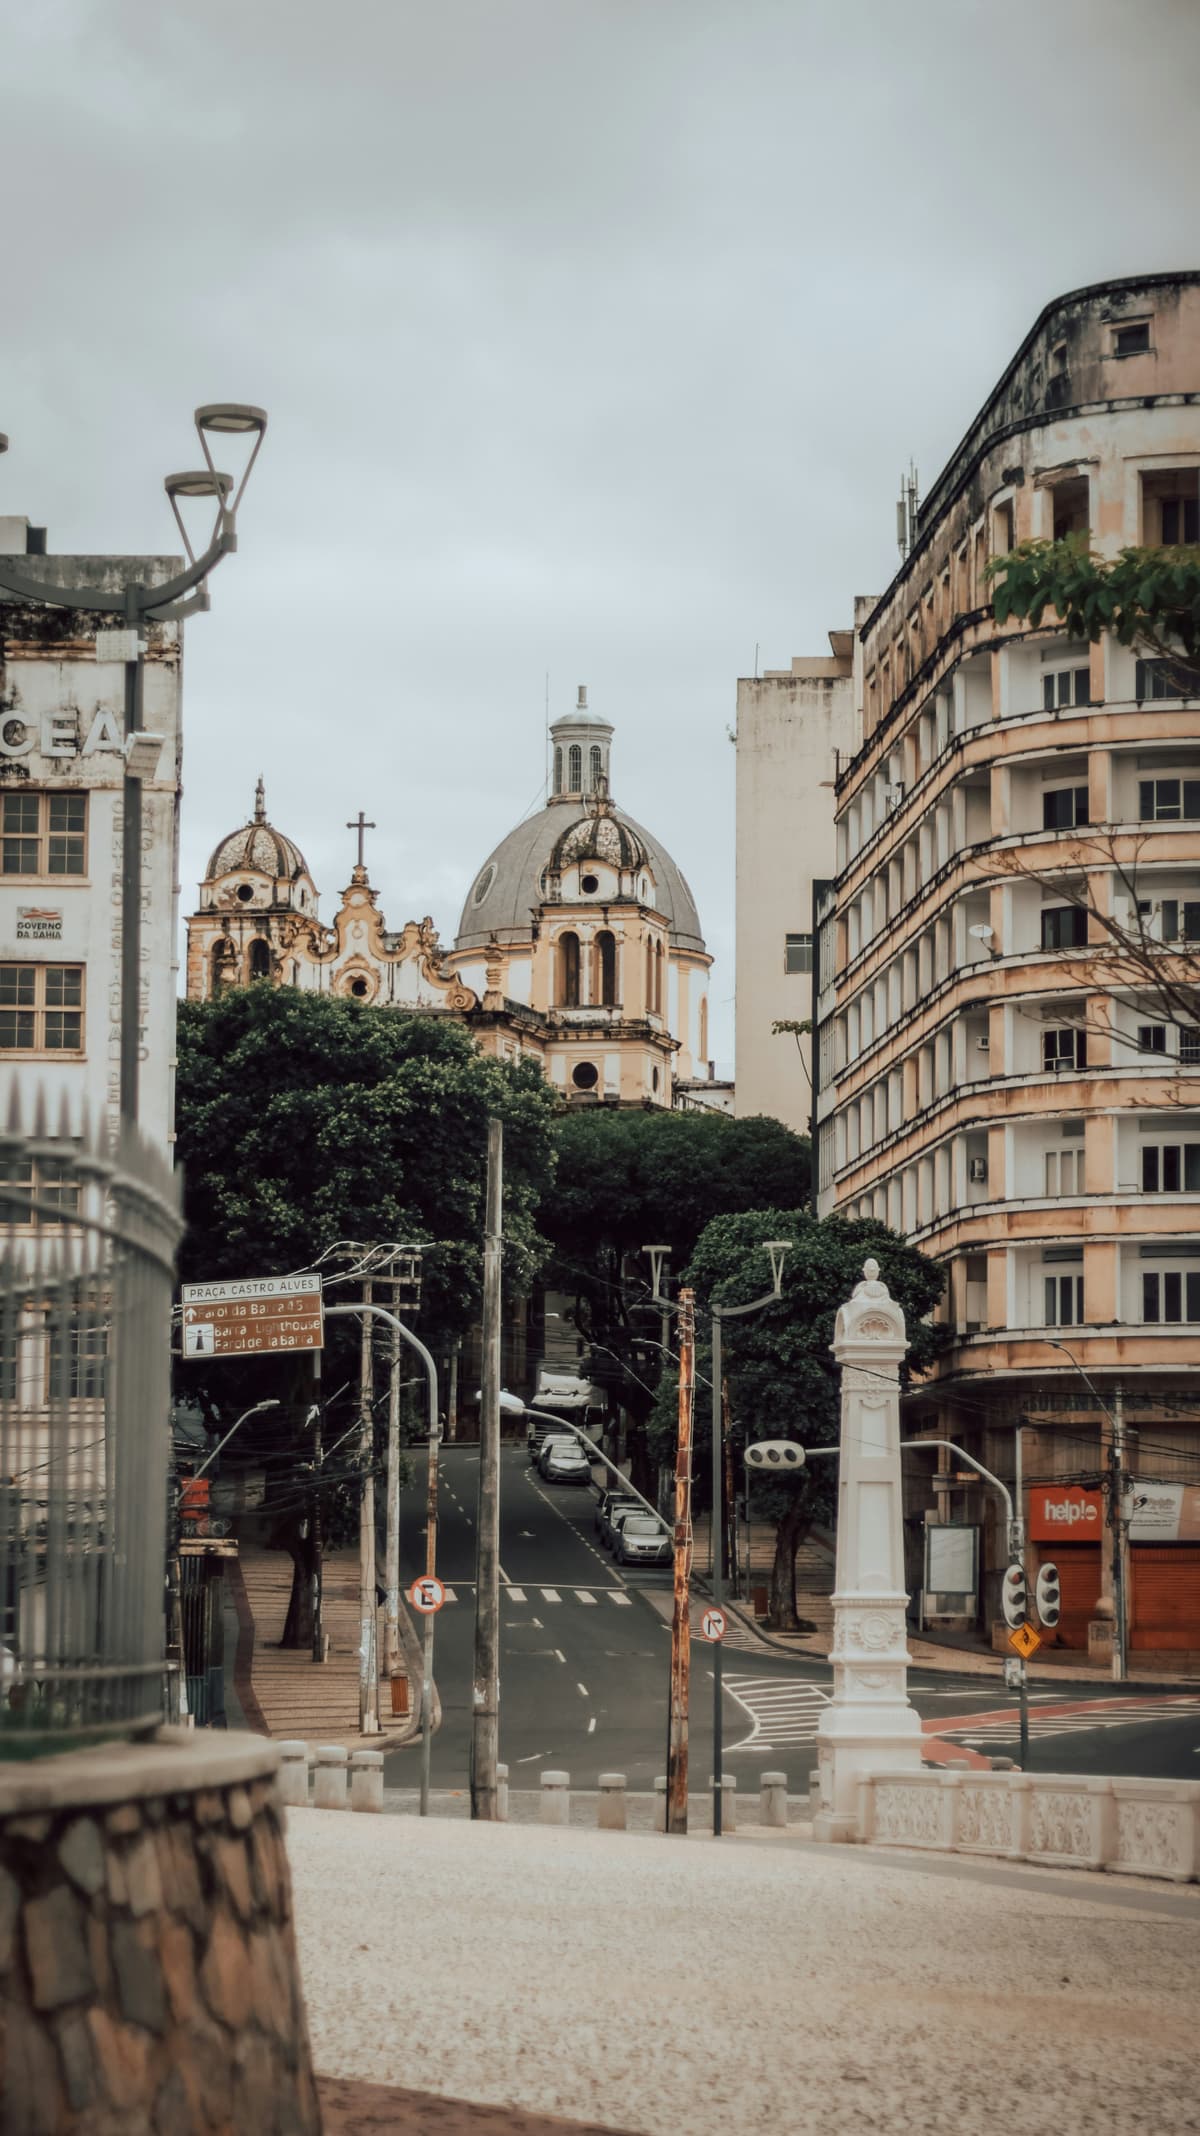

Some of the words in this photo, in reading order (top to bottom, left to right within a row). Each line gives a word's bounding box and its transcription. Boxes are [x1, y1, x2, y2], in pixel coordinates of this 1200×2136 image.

[17, 922, 62, 930] GOVERNO
[17, 931, 30, 939] DA
[33, 931, 62, 939] BAHIA
[231, 1283, 274, 1295] CASTRO
[280, 1279, 314, 1290] ALVES
[232, 1304, 246, 1315] da
[214, 1325, 247, 1336] Barra
[256, 1320, 320, 1335] Lighthouse
[215, 1338, 245, 1349] Farol
[247, 1338, 262, 1348] de
[268, 1336, 278, 1347] la
[280, 1334, 314, 1345] Barra
[421, 1584, 435, 1605] E
